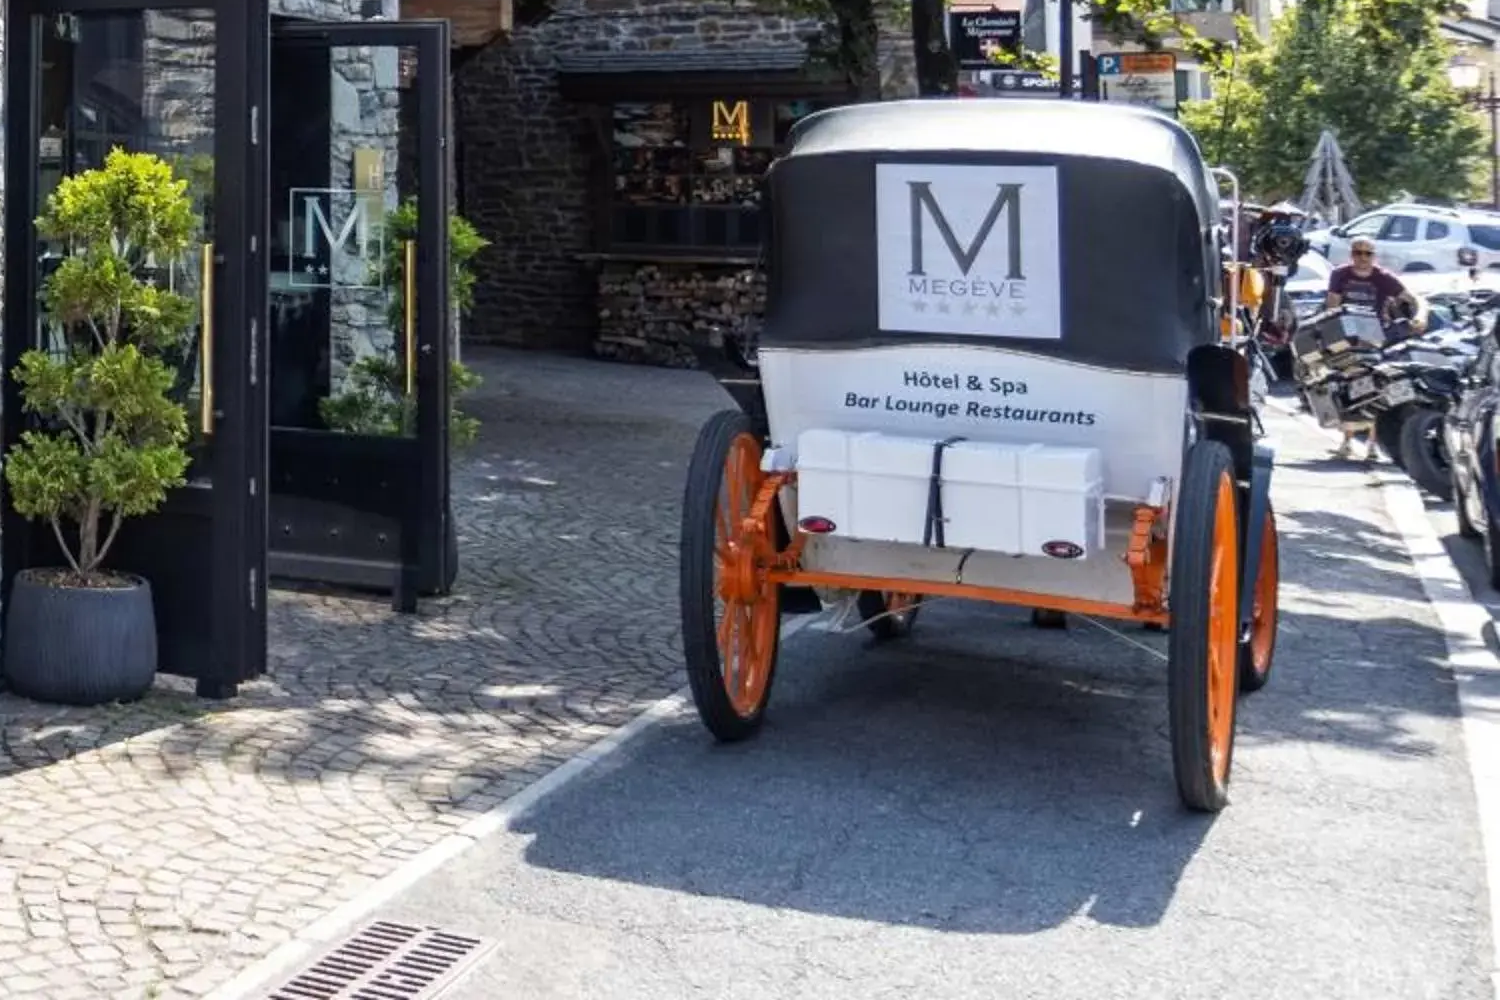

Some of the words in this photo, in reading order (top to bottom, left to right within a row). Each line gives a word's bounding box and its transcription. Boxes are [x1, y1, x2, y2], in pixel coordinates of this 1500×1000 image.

[304, 196, 369, 259] M
[907, 180, 1027, 281] M
[908, 276, 1026, 299] MEGÈVE
[903, 371, 960, 391] Hôtel
[966, 375, 983, 391] &
[989, 377, 1029, 397] Spa
[844, 391, 880, 409] Bar
[885, 395, 960, 418] Lounge
[966, 401, 1096, 426] Restaurants
